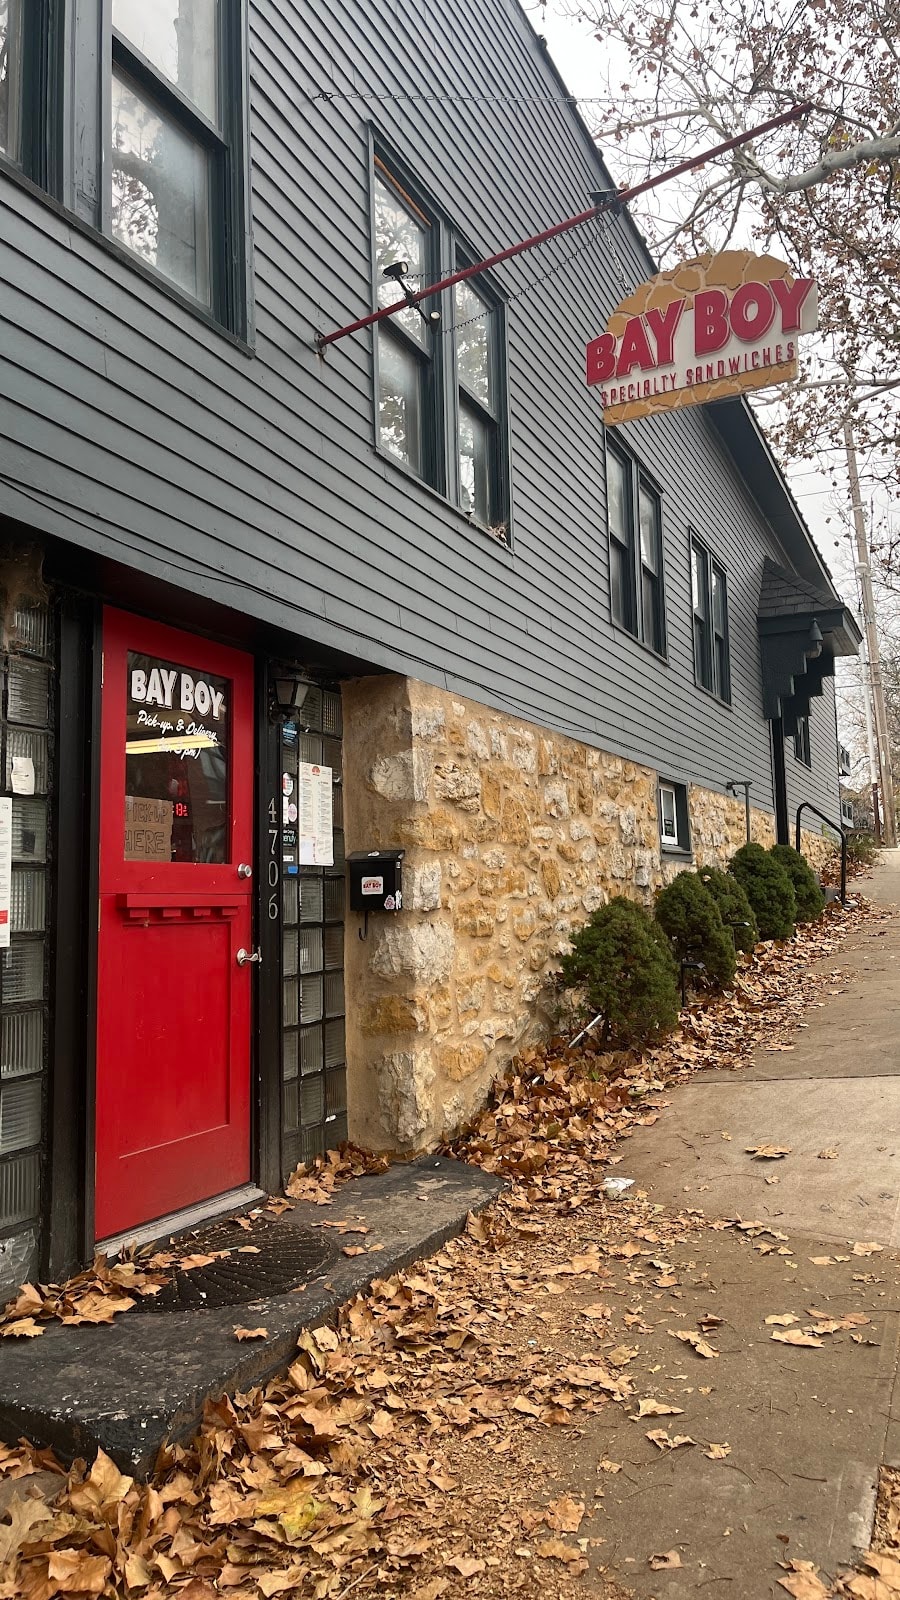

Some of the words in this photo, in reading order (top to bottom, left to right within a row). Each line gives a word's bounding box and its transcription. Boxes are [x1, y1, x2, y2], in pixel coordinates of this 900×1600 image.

[586, 298, 686, 387] BAY
[693, 278, 814, 357] BOY
[601, 372, 678, 406] SPECIALTY
[686, 341, 795, 385] SANDWICHES
[131, 668, 177, 710] BAY
[180, 673, 224, 720] BOY
[137, 710, 174, 735] Pick-up
[176, 718, 185, 732] &
[185, 722, 218, 742] Delivery
[124, 830, 165, 854] HERE
[268, 798, 278, 920] 4706
